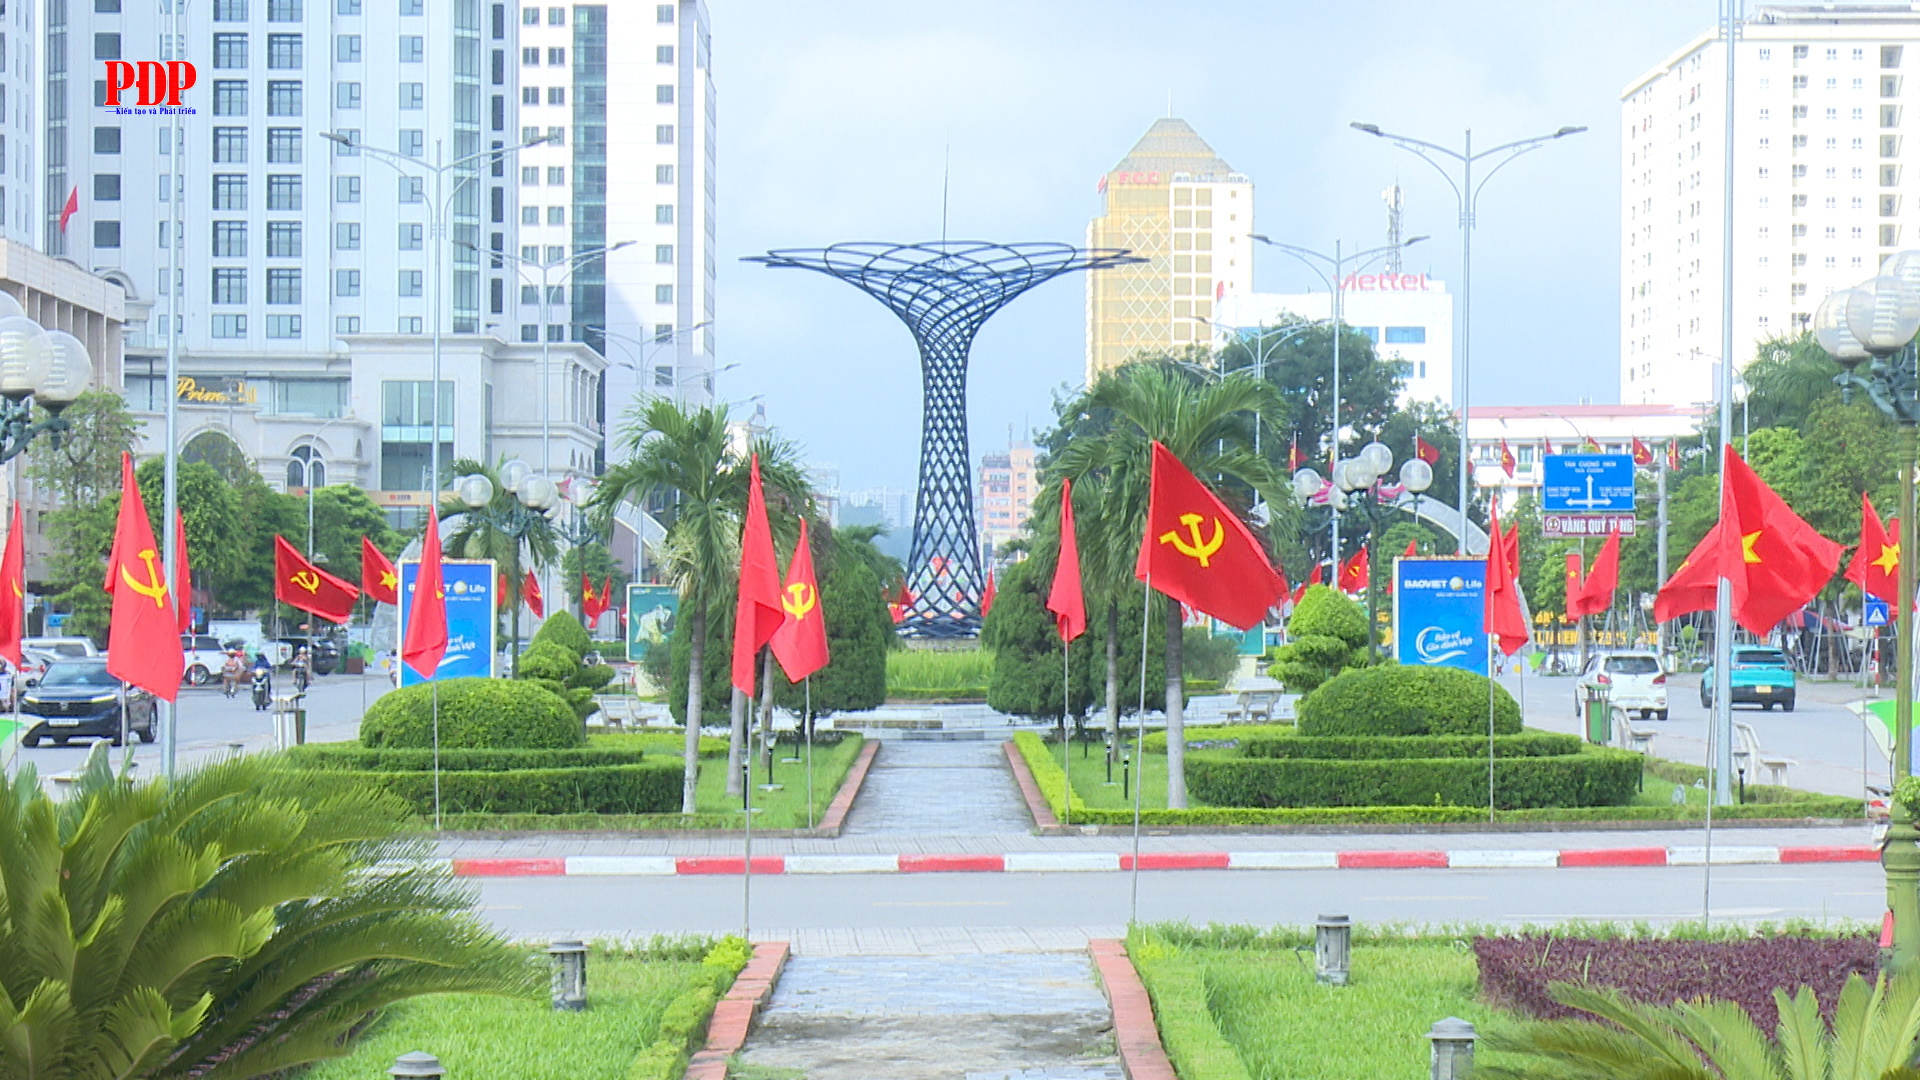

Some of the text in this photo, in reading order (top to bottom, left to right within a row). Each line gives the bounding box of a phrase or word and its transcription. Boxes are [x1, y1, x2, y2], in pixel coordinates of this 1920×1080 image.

[1332, 270, 1429, 291] viettel
[1561, 516, 1587, 533] VÀNG
[469, 584, 486, 593] Life
